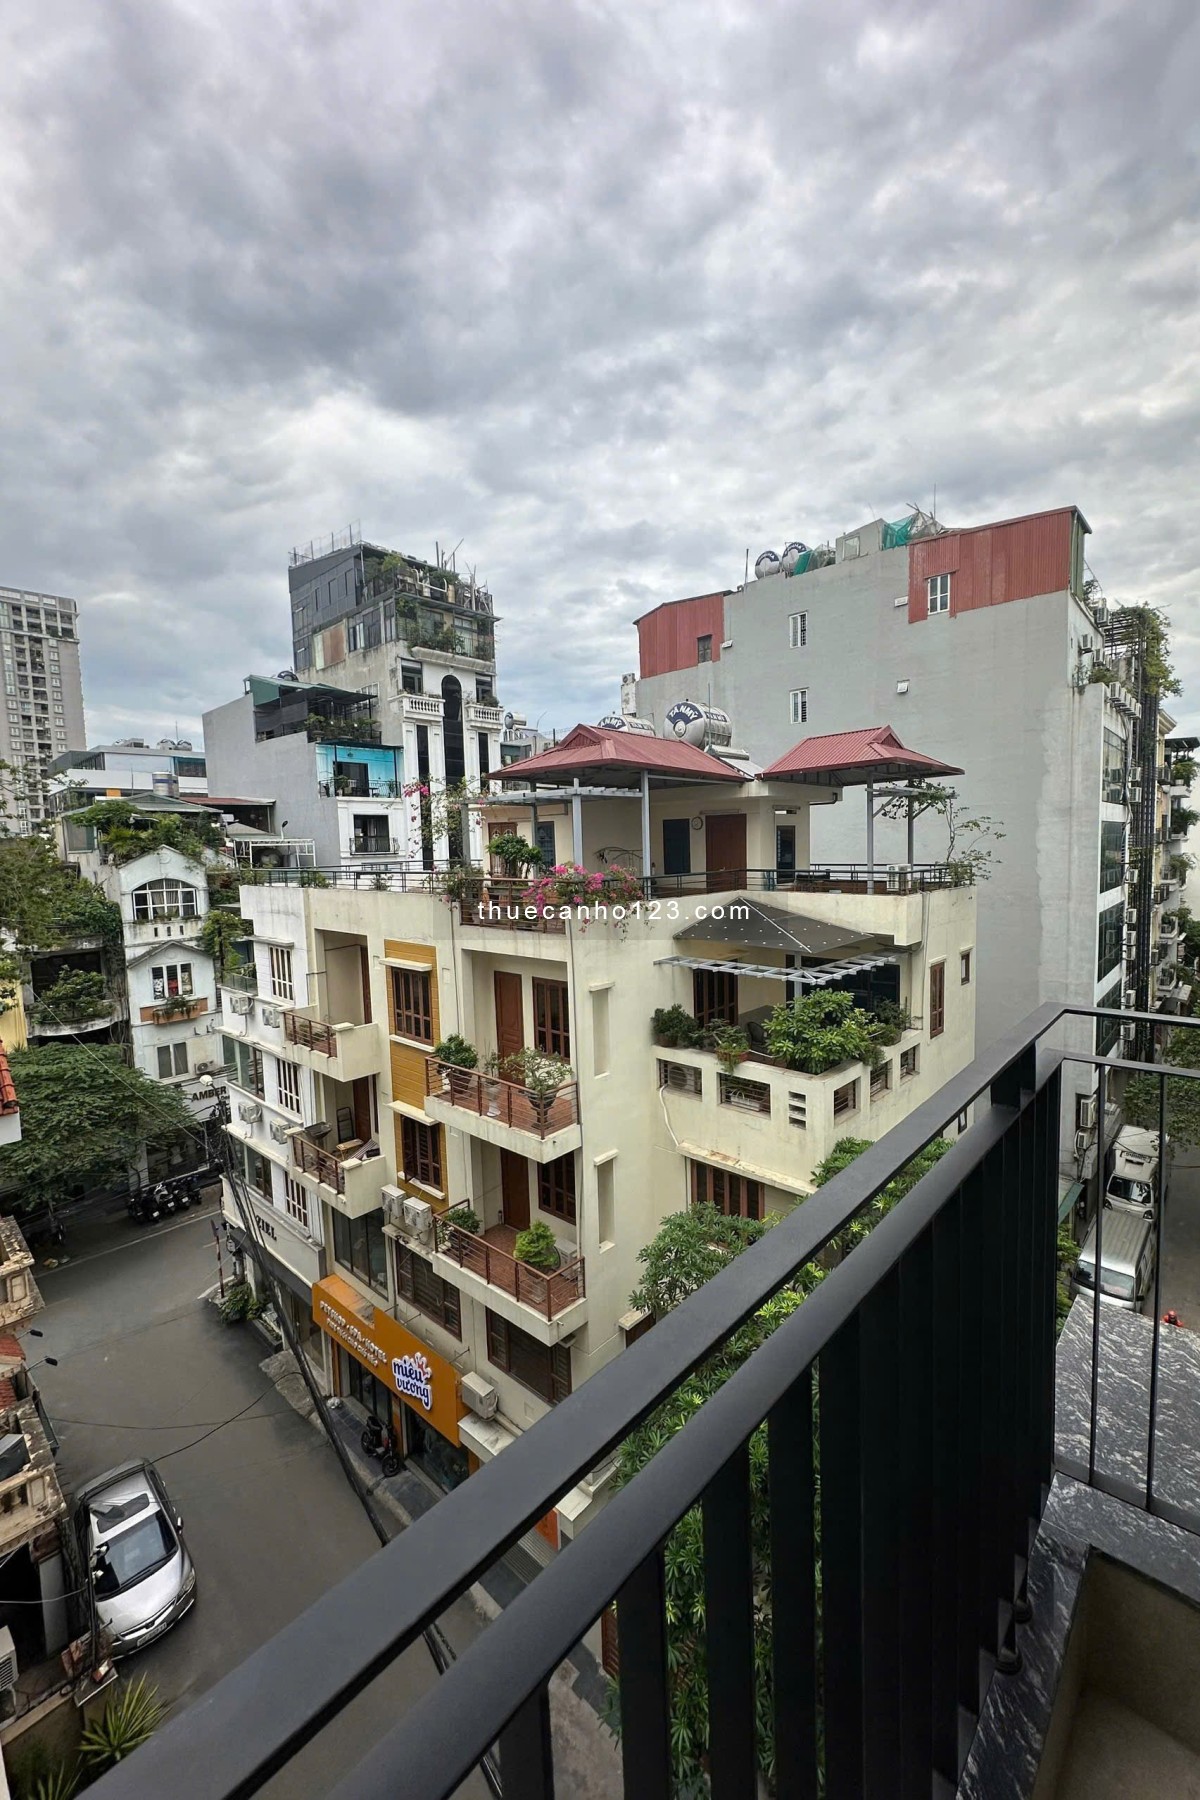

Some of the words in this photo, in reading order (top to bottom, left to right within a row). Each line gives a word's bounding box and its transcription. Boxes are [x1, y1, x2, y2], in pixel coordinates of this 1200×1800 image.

[192, 1086, 227, 1102] AMBER
[365, 1338, 387, 1364] HOTEL
[393, 1359, 424, 1384] miêu
[397, 1377, 431, 1408] vương
